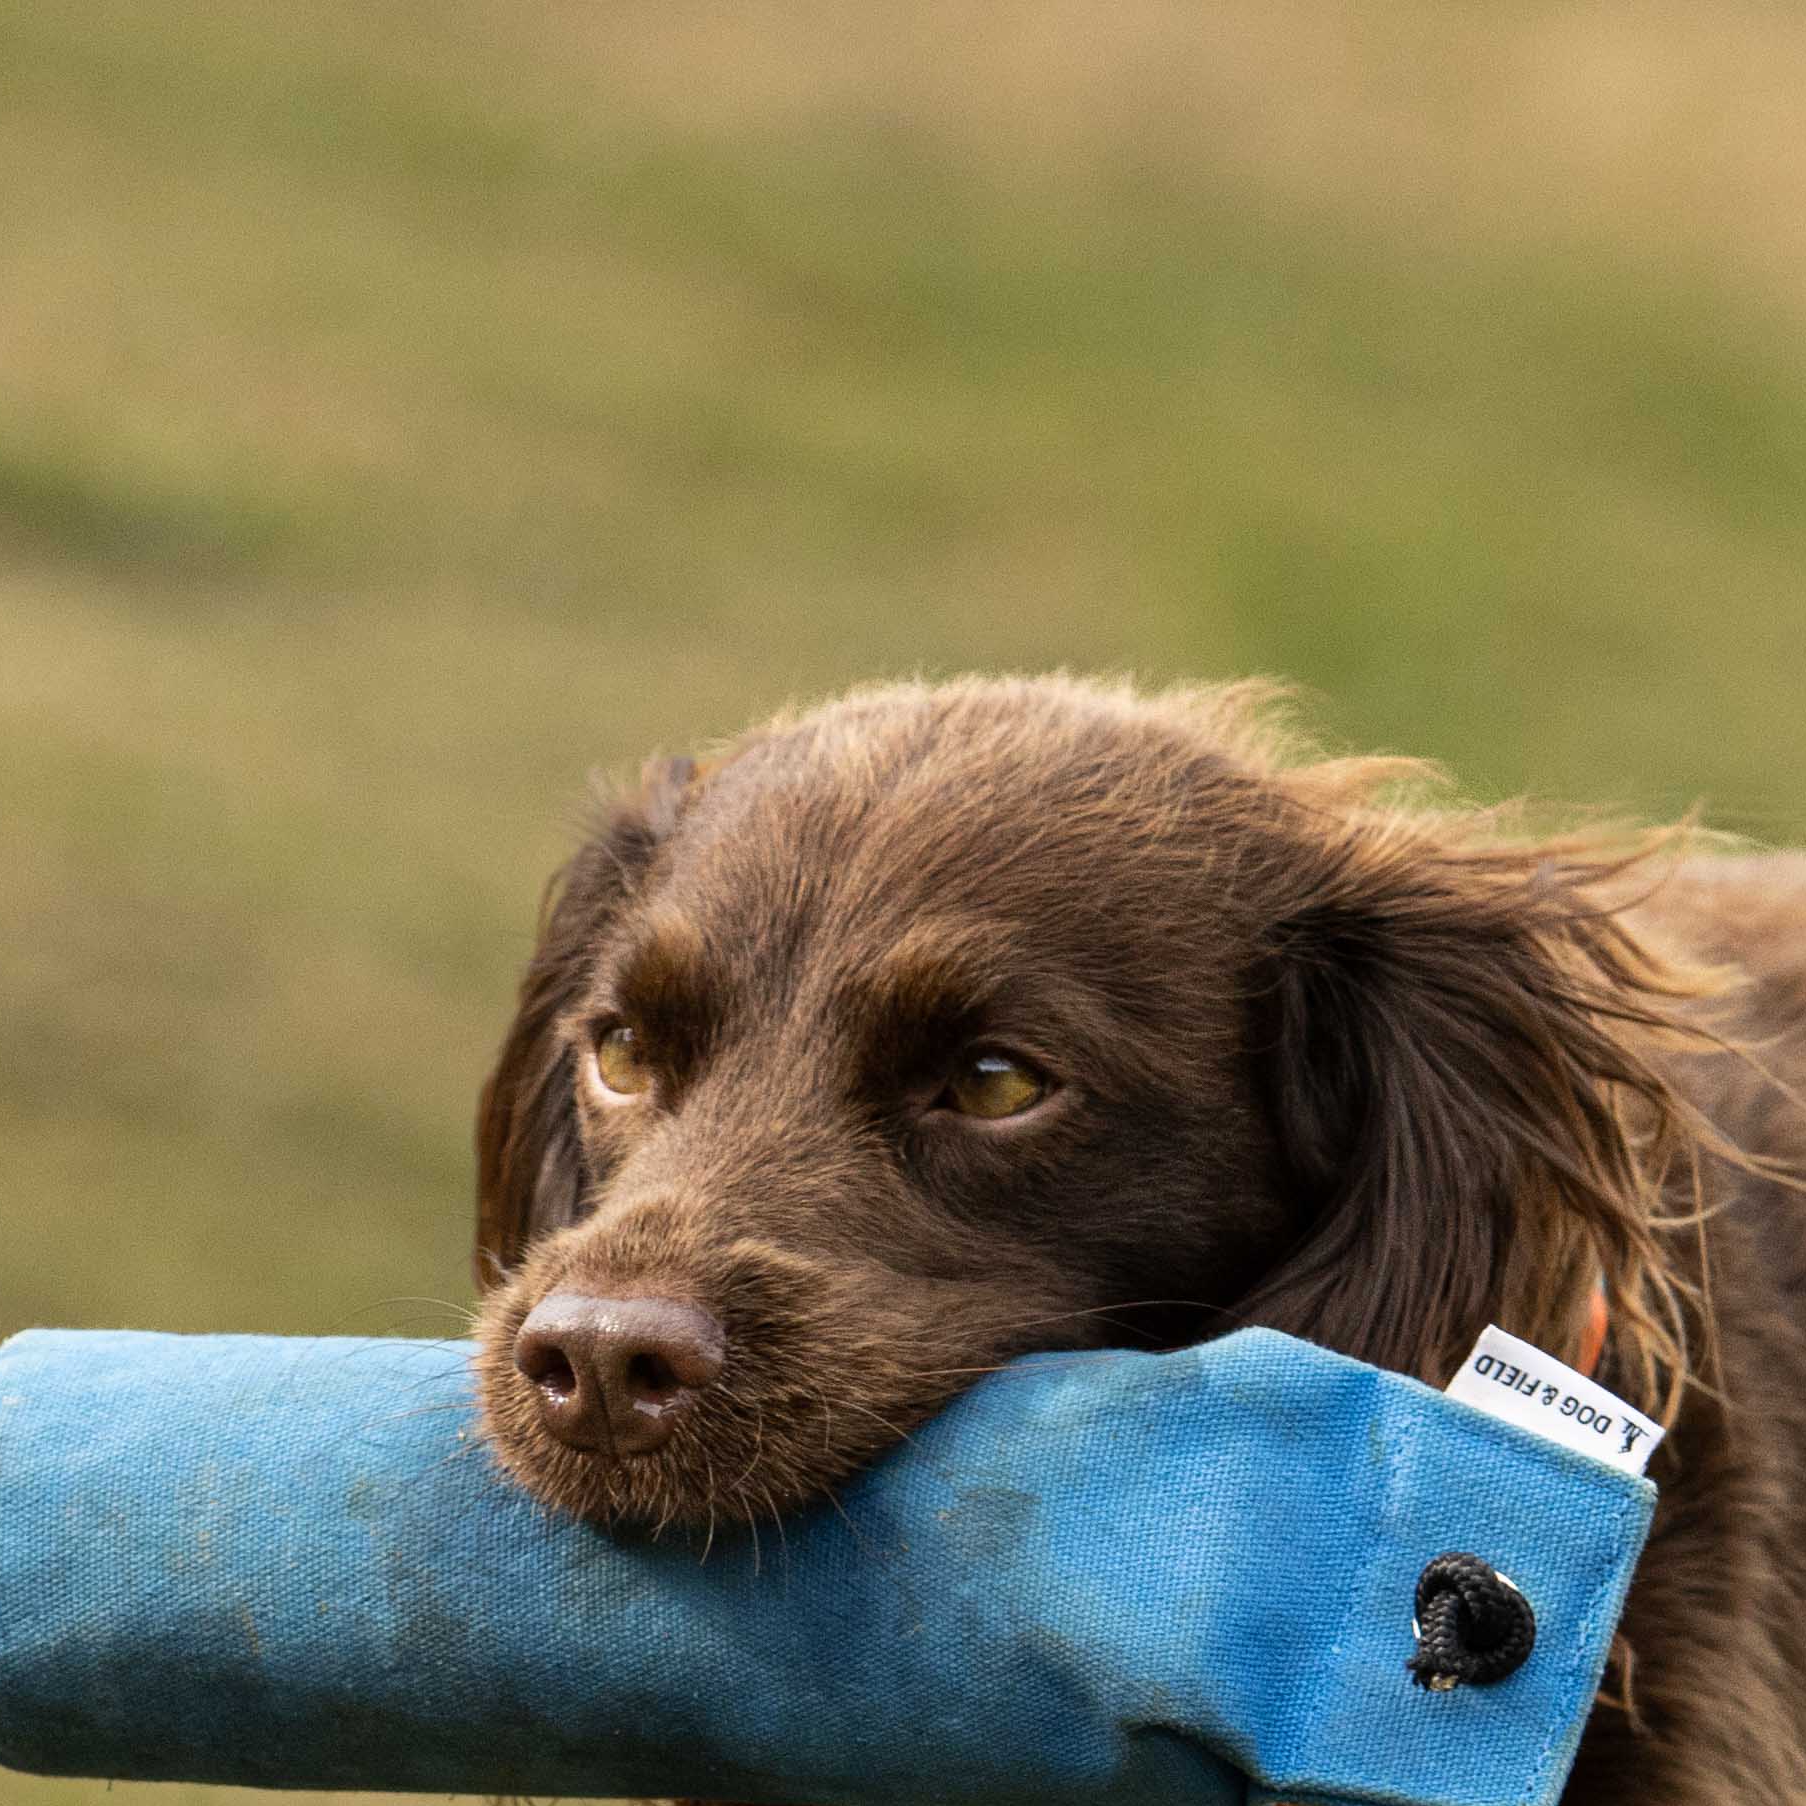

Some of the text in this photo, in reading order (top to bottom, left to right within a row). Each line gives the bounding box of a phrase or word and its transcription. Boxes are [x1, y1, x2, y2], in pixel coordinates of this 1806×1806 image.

[1475, 1355, 1612, 1434] DOG & FIELD
